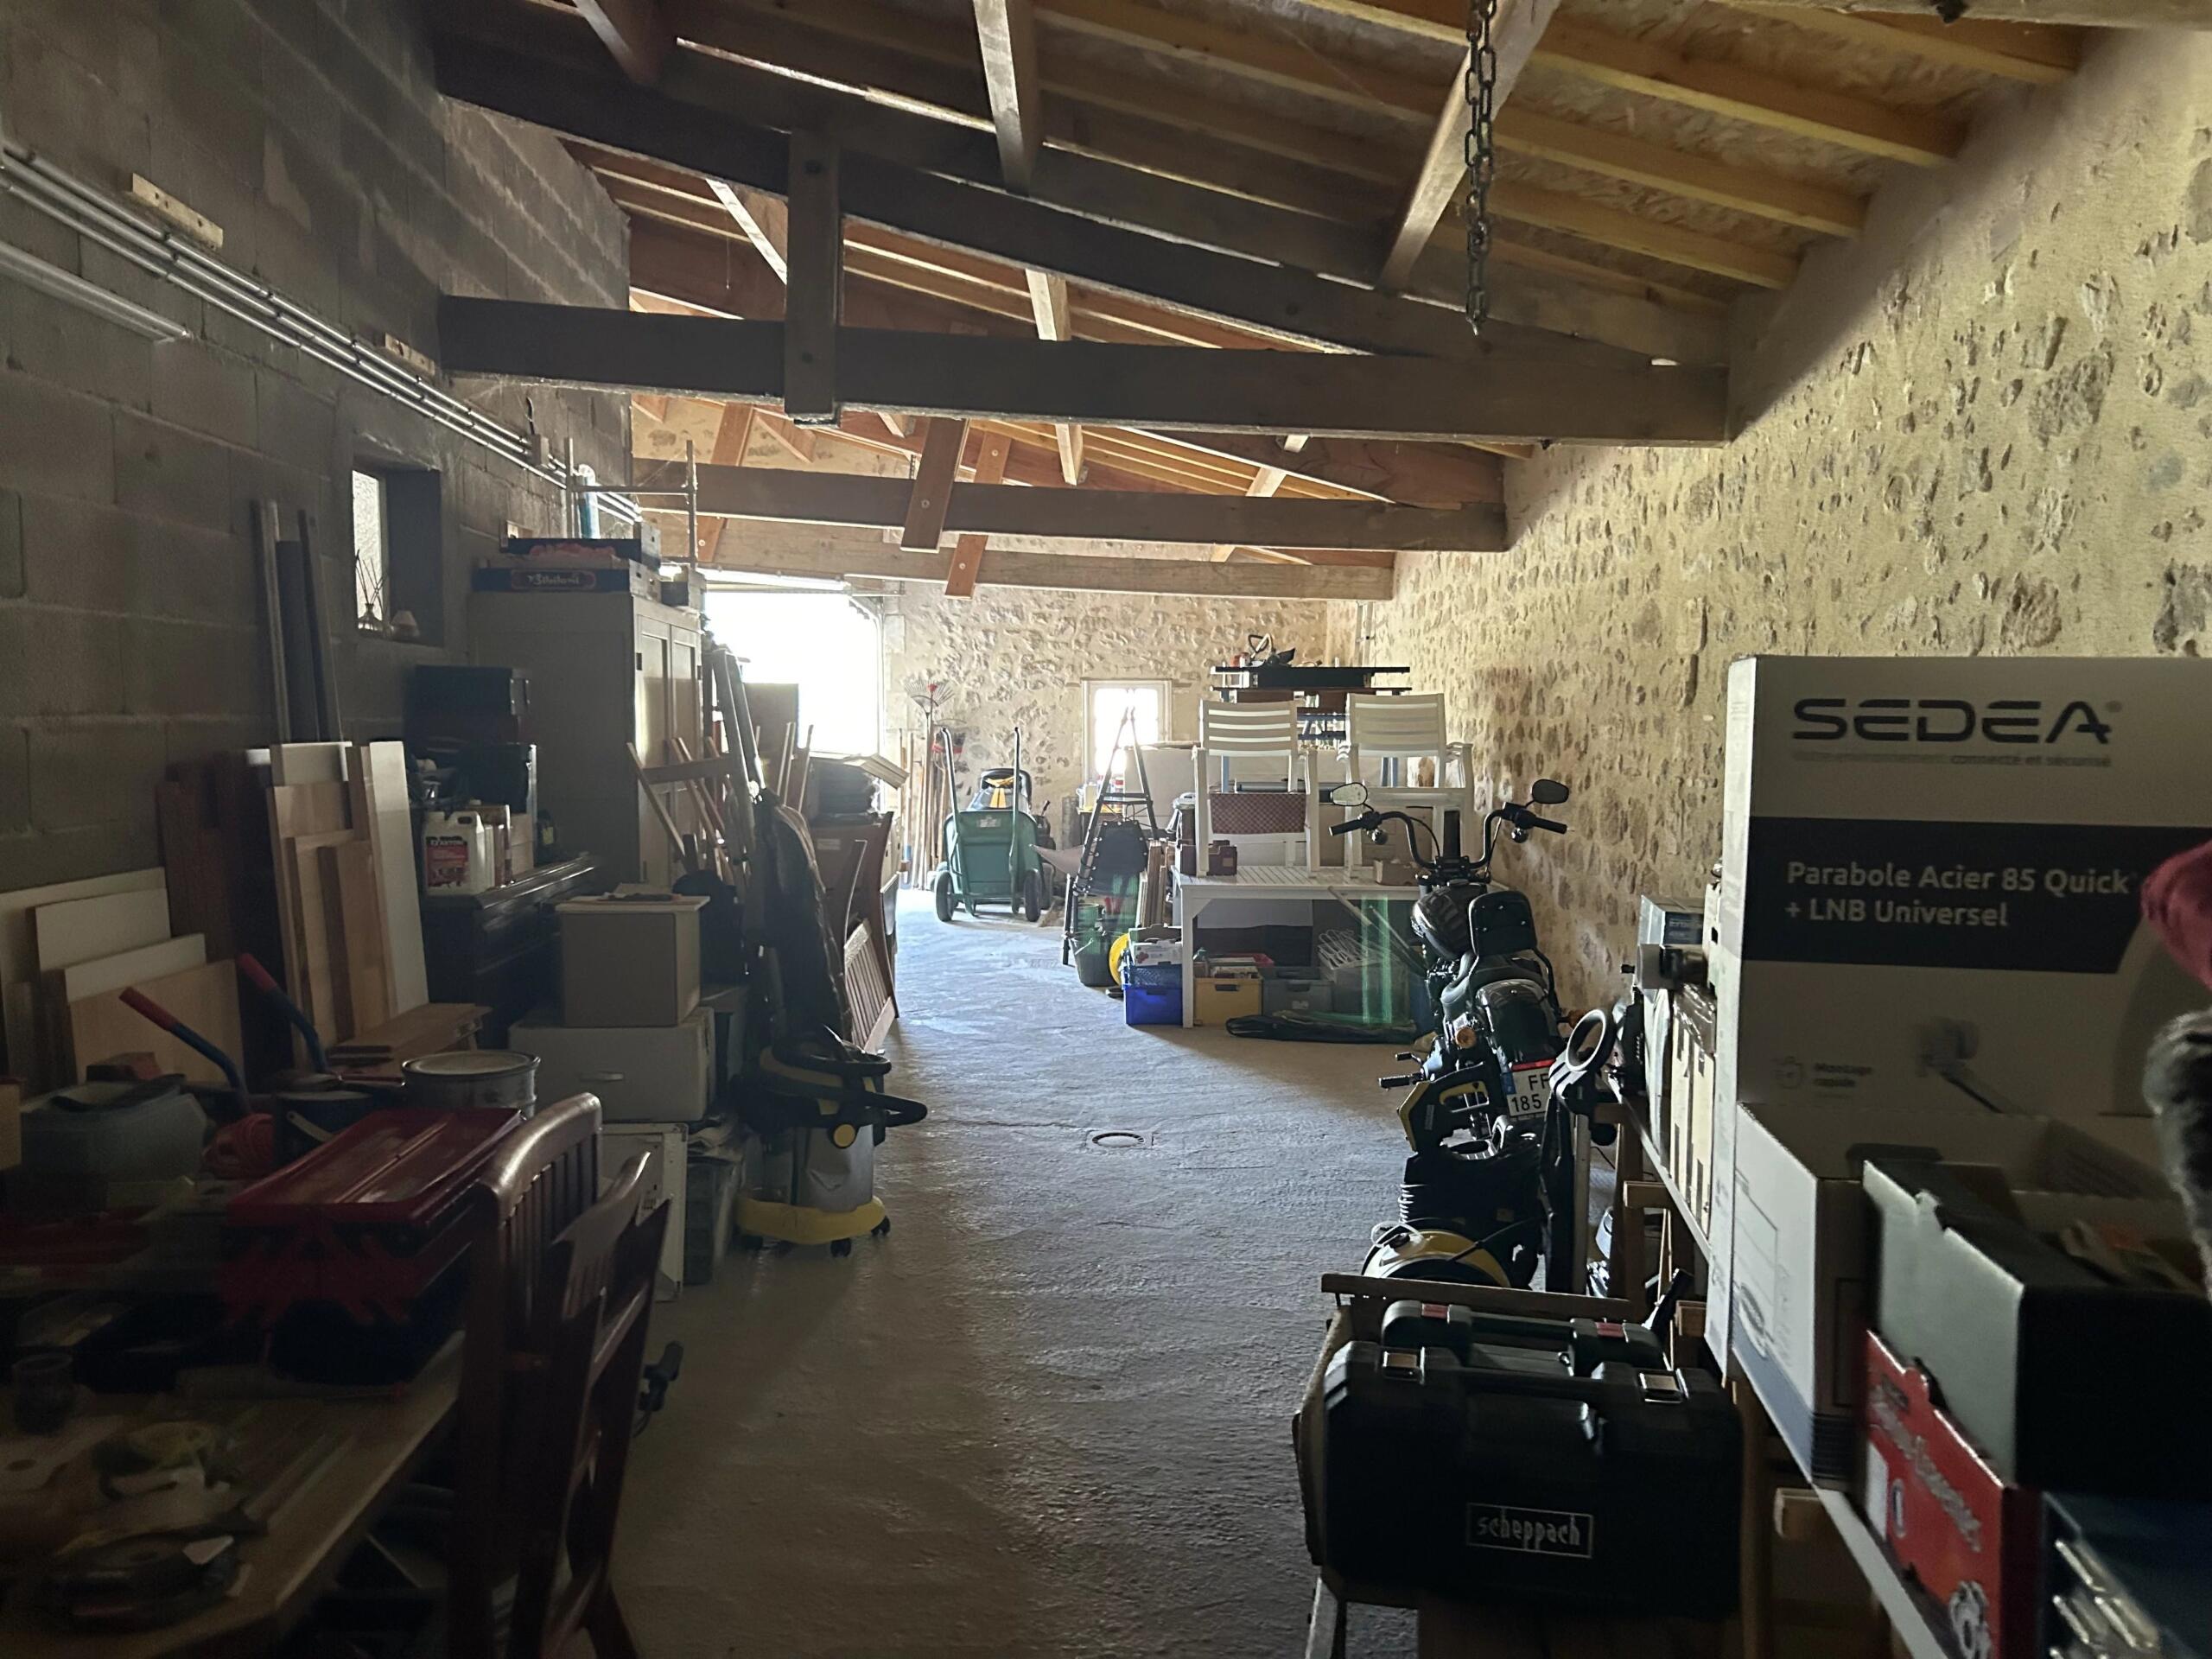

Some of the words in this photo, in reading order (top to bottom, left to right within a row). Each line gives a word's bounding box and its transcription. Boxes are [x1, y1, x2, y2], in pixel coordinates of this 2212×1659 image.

[1794, 698, 2112, 744] SEDEA
[1786, 861, 1911, 888] Parabole
[1918, 864, 1995, 891] Acier
[2001, 868, 2036, 892] 85
[2044, 869, 2130, 899] Quick
[1784, 903, 1802, 918] +
[1809, 898, 1866, 921] LNB
[1874, 899, 2009, 927] Universel
[1511, 1094, 1541, 1113] 185
[1476, 1507, 1581, 1550] scheppach
